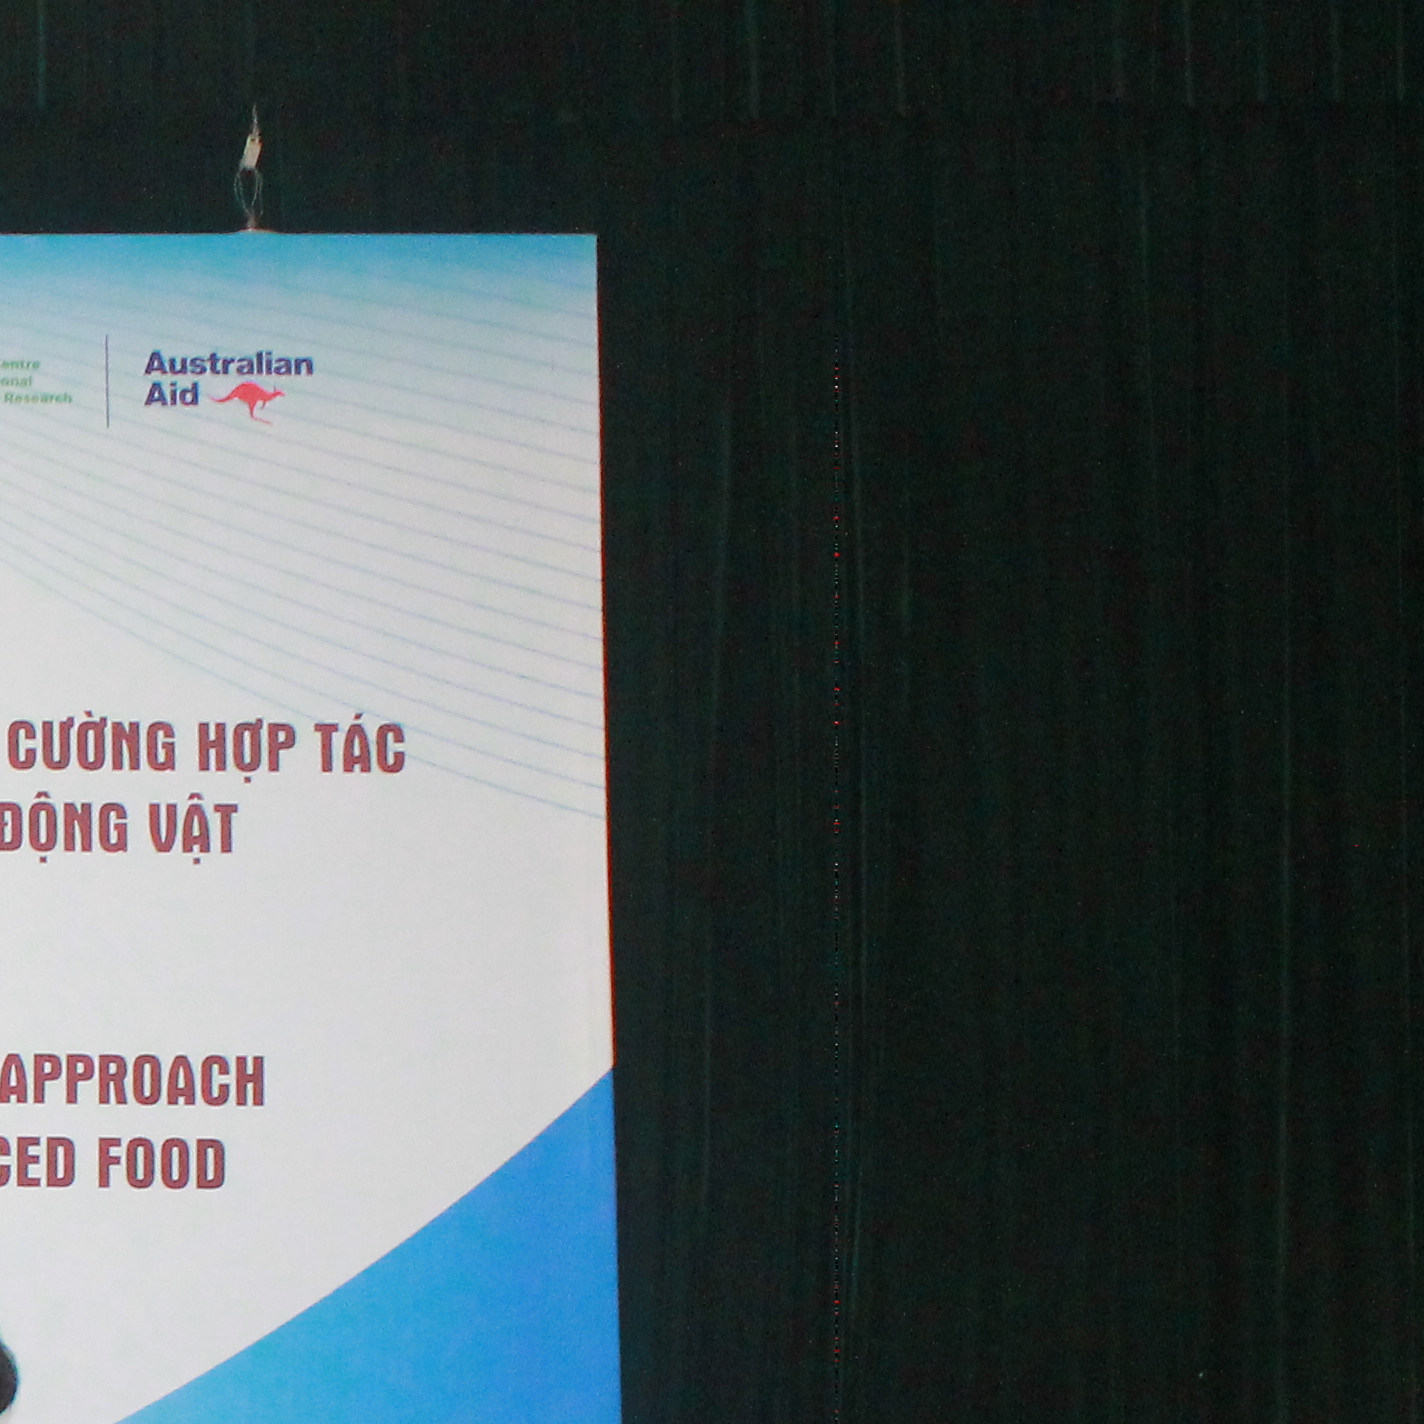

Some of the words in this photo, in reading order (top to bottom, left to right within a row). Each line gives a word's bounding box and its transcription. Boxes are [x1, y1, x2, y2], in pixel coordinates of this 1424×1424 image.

[145, 350, 316, 376] Australian
[4, 392, 74, 405] Research
[145, 382, 201, 407] Aid
[8, 711, 176, 772] CƯỜNG
[198, 718, 298, 783] HỢP
[315, 712, 407, 774] TÁC
[149, 793, 240, 866] VẬT
[0, 1054, 266, 1107] APPROACH
[98, 1137, 228, 1190] FOOD
